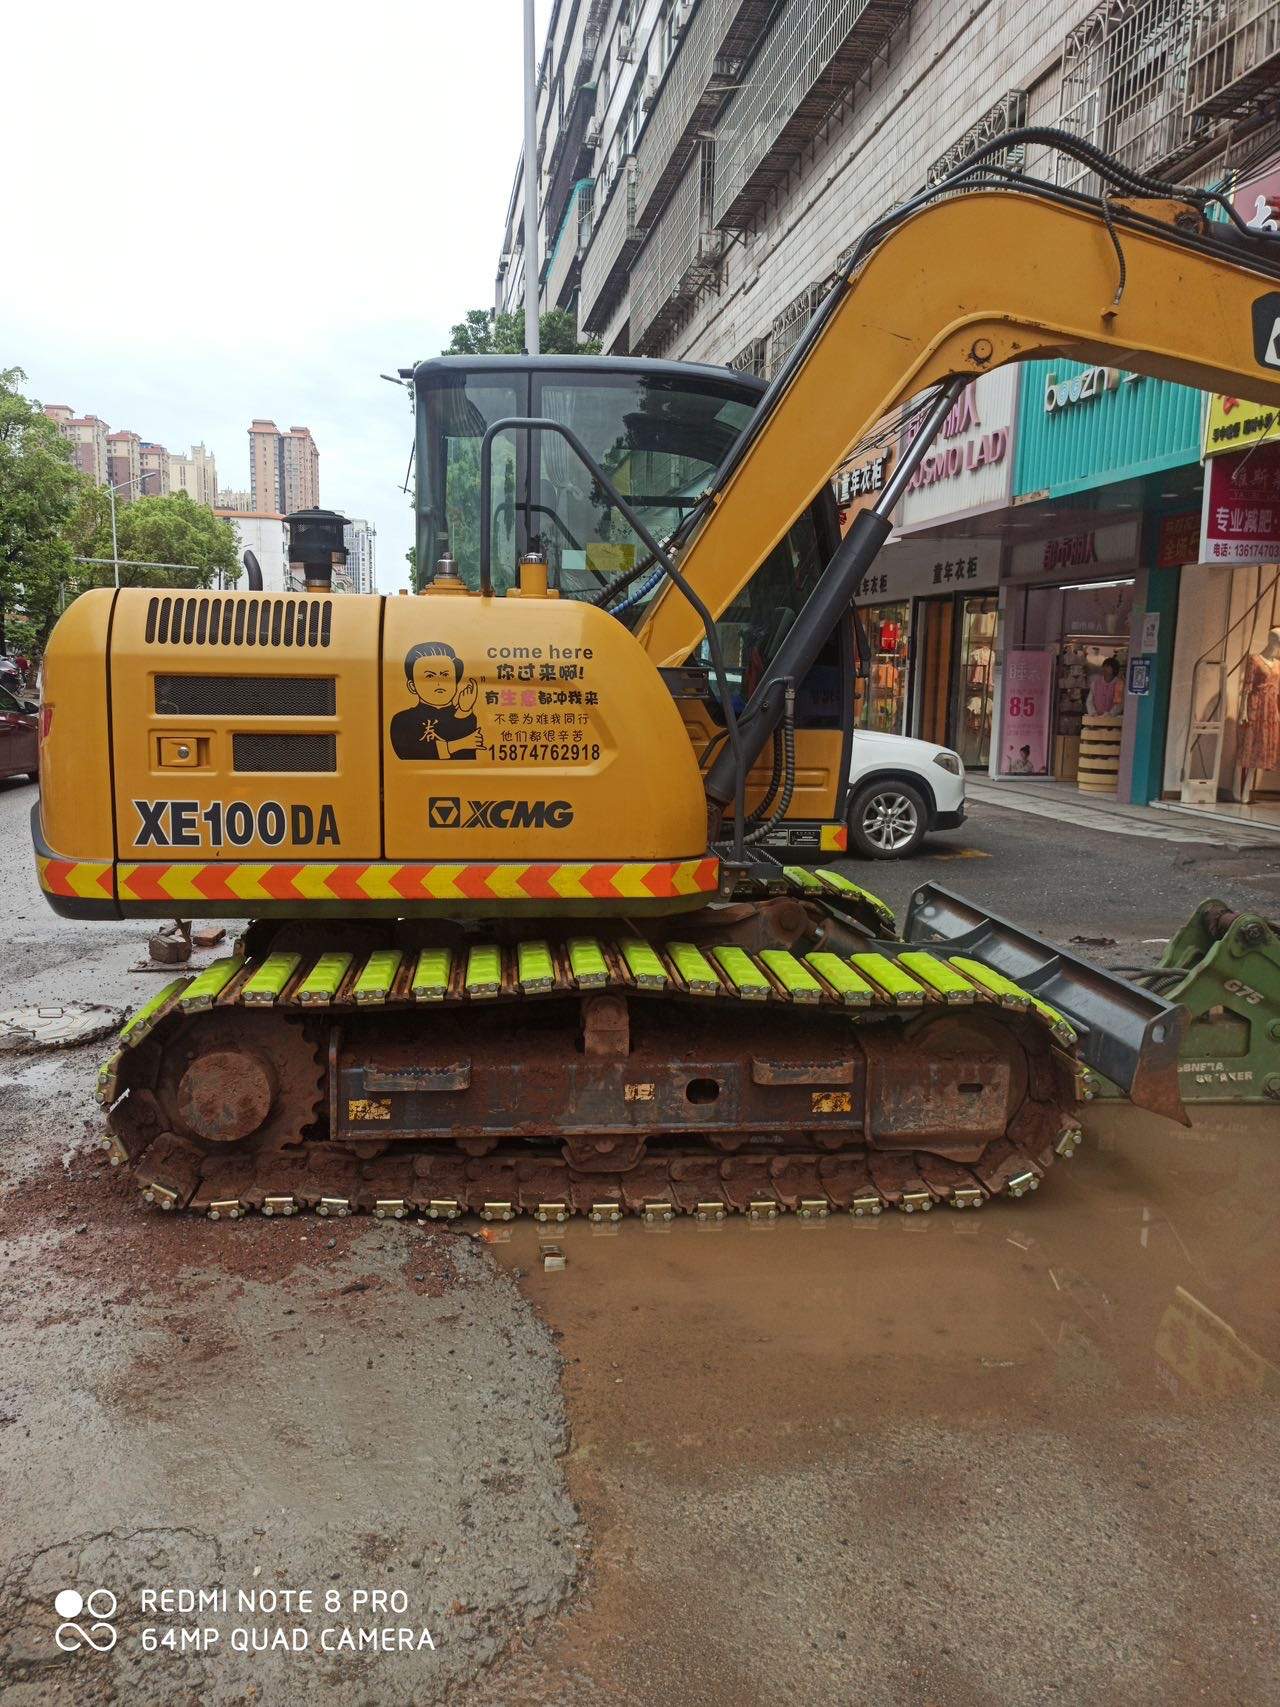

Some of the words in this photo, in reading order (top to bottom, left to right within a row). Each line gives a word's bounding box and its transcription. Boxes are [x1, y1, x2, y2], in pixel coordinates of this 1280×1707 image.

[840, 457, 884, 502] 童年衣柜
[933, 556, 978, 584] 童年衣柜
[486, 647, 542, 659] come
[549, 644, 593, 659] here
[496, 663, 584, 681] 你过来啊!
[485, 689, 599, 707] 有生意都冲我来
[1009, 697, 1035, 717] 85
[494, 713, 590, 725] 不要为难我同行
[500, 730, 584, 742] 他们都很辛苦
[488, 744, 600, 761] 15874762918
[133, 800, 341, 847] XE100DA
[461, 800, 574, 828] XCMG
[1224, 979, 1264, 1005] G75
